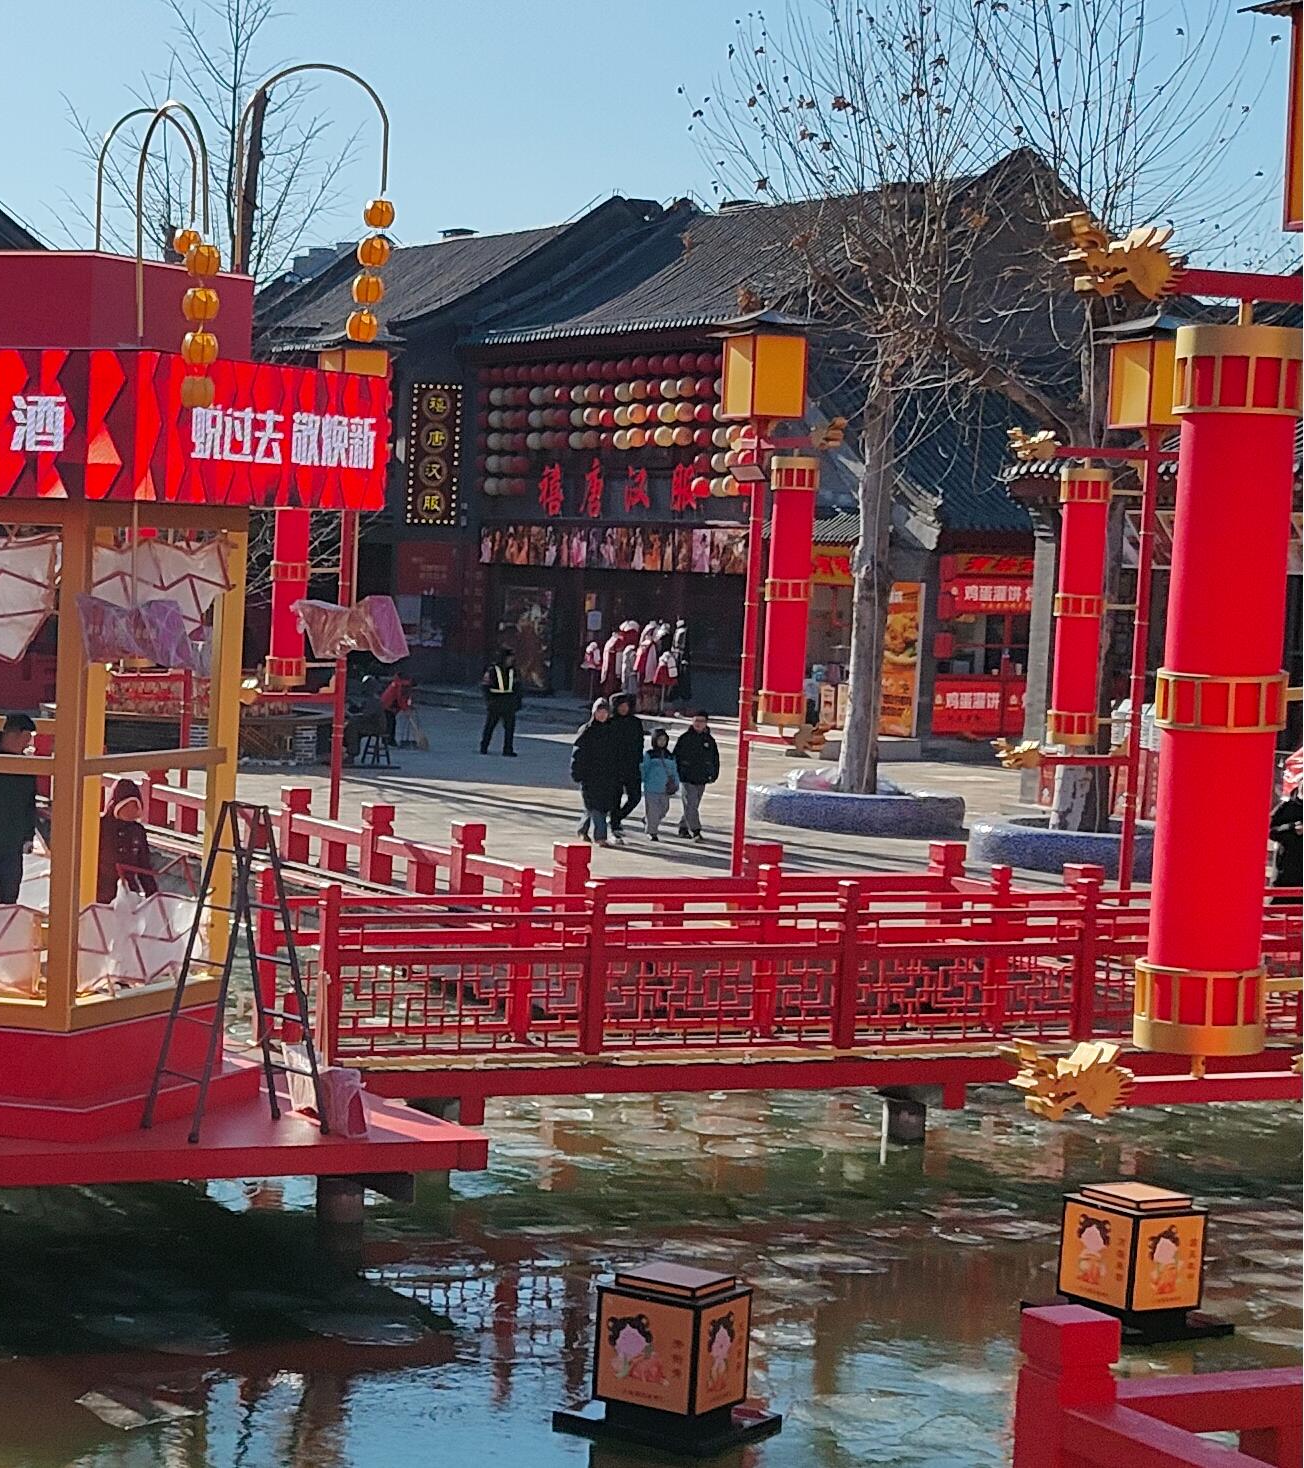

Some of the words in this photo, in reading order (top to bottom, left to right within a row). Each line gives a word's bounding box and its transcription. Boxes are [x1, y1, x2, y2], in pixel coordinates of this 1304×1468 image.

[190, 405, 285, 465] 蜕过去
[291, 411, 377, 470] 敬焕新
[964, 585, 1022, 602] 鸡蛋灌饼
[945, 692, 1000, 710] 鸡蛋灌饼
